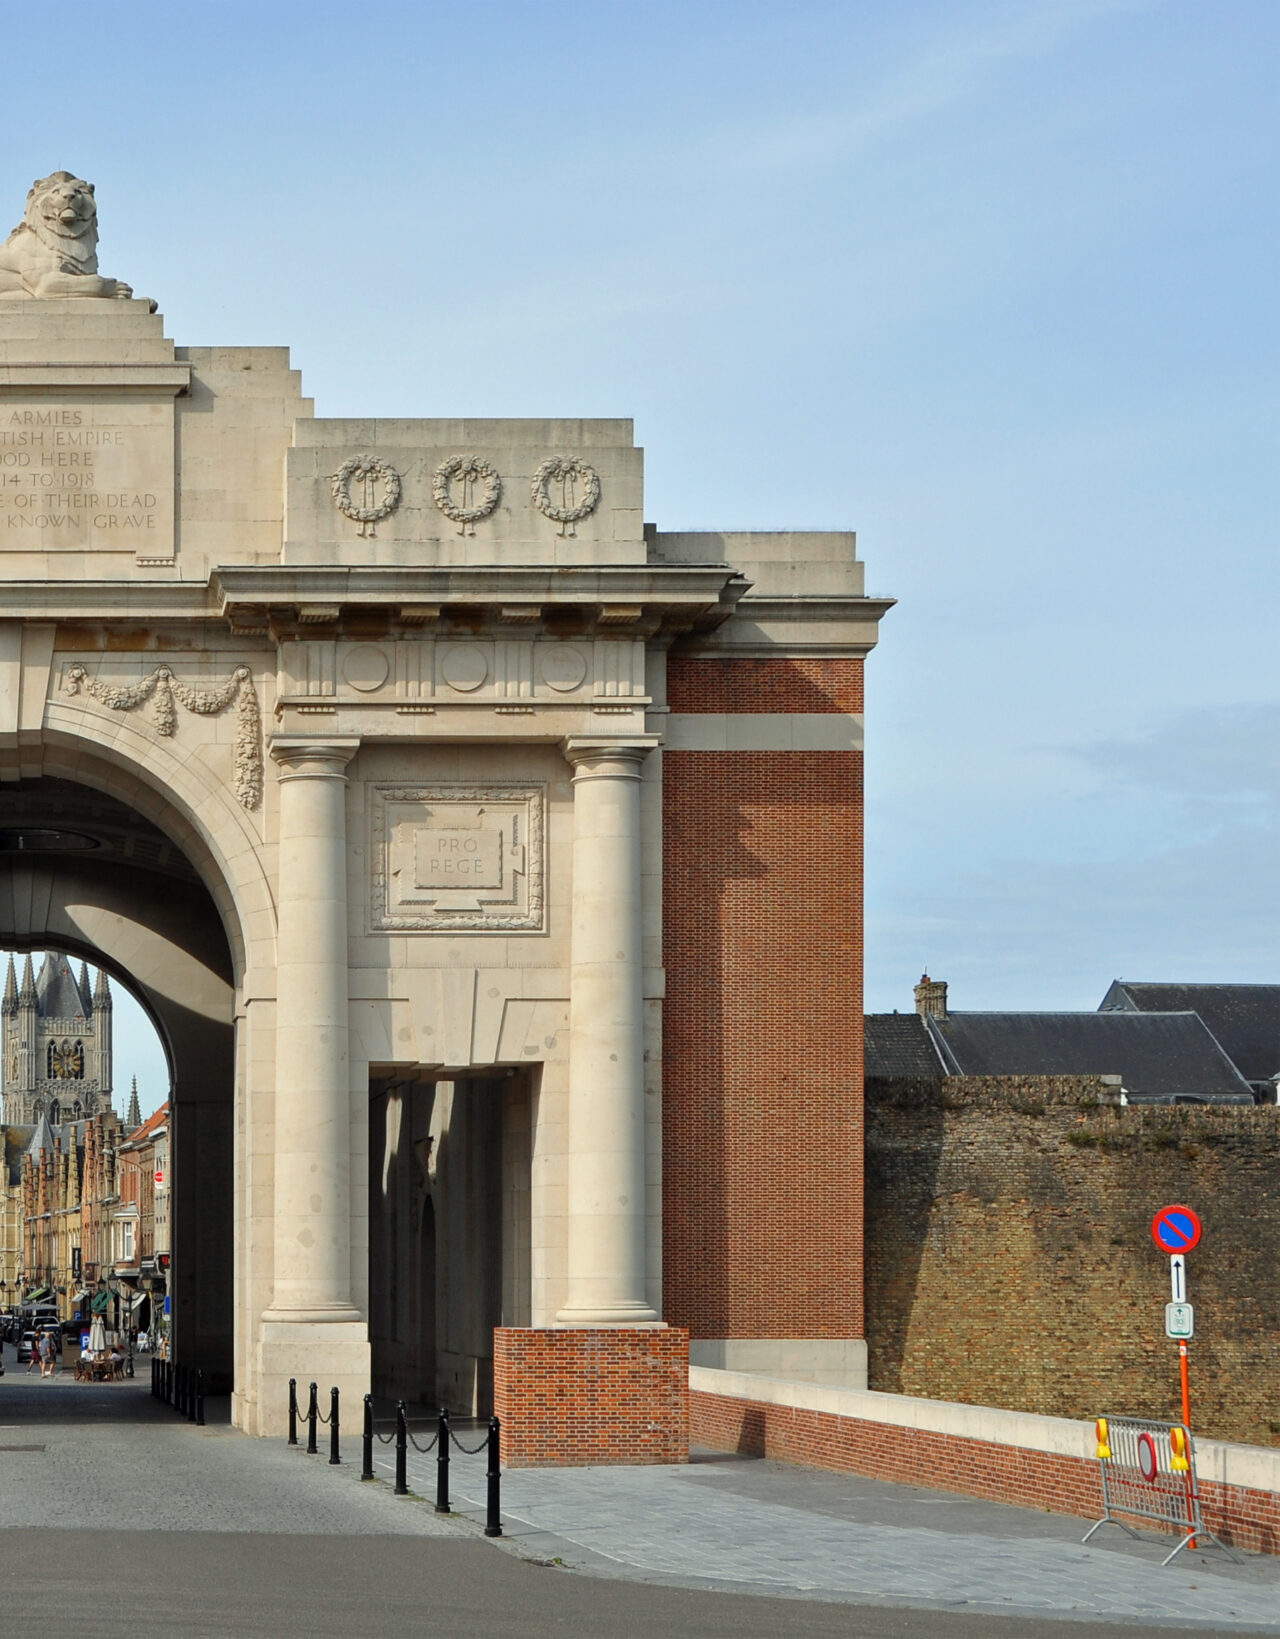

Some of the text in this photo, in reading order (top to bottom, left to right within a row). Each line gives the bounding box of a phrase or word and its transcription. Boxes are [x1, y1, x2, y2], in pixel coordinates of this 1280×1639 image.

[9, 410, 83, 426] ARMIES
[55, 431, 125, 447] EMPIRE
[40, 451, 94, 468] HERE
[28, 472, 54, 488] TO
[58, 472, 95, 488] 1918
[14, 493, 38, 509] OF
[44, 493, 100, 509] THEIR
[106, 493, 157, 509] DEAD
[7, 514, 81, 530] KNOWN
[93, 514, 157, 530] GRAVE
[437, 838, 478, 853] PRO
[430, 859, 485, 874] REGE
